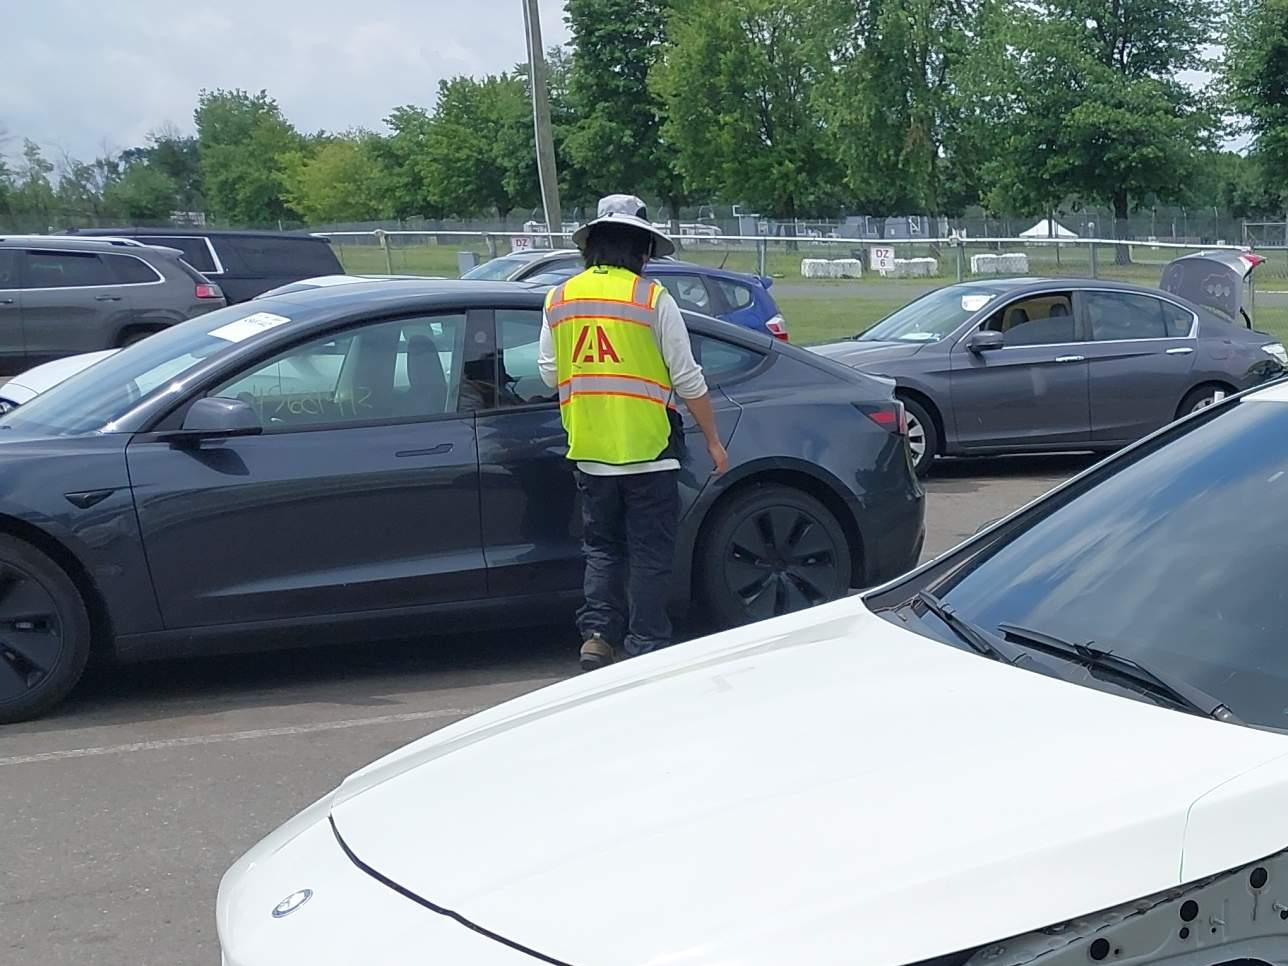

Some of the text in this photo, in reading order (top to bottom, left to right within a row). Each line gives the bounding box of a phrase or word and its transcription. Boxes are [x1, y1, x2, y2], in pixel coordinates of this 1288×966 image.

[516, 239, 528, 247] DZ
[876, 249, 889, 258] DZ
[880, 259, 886, 267] 6
